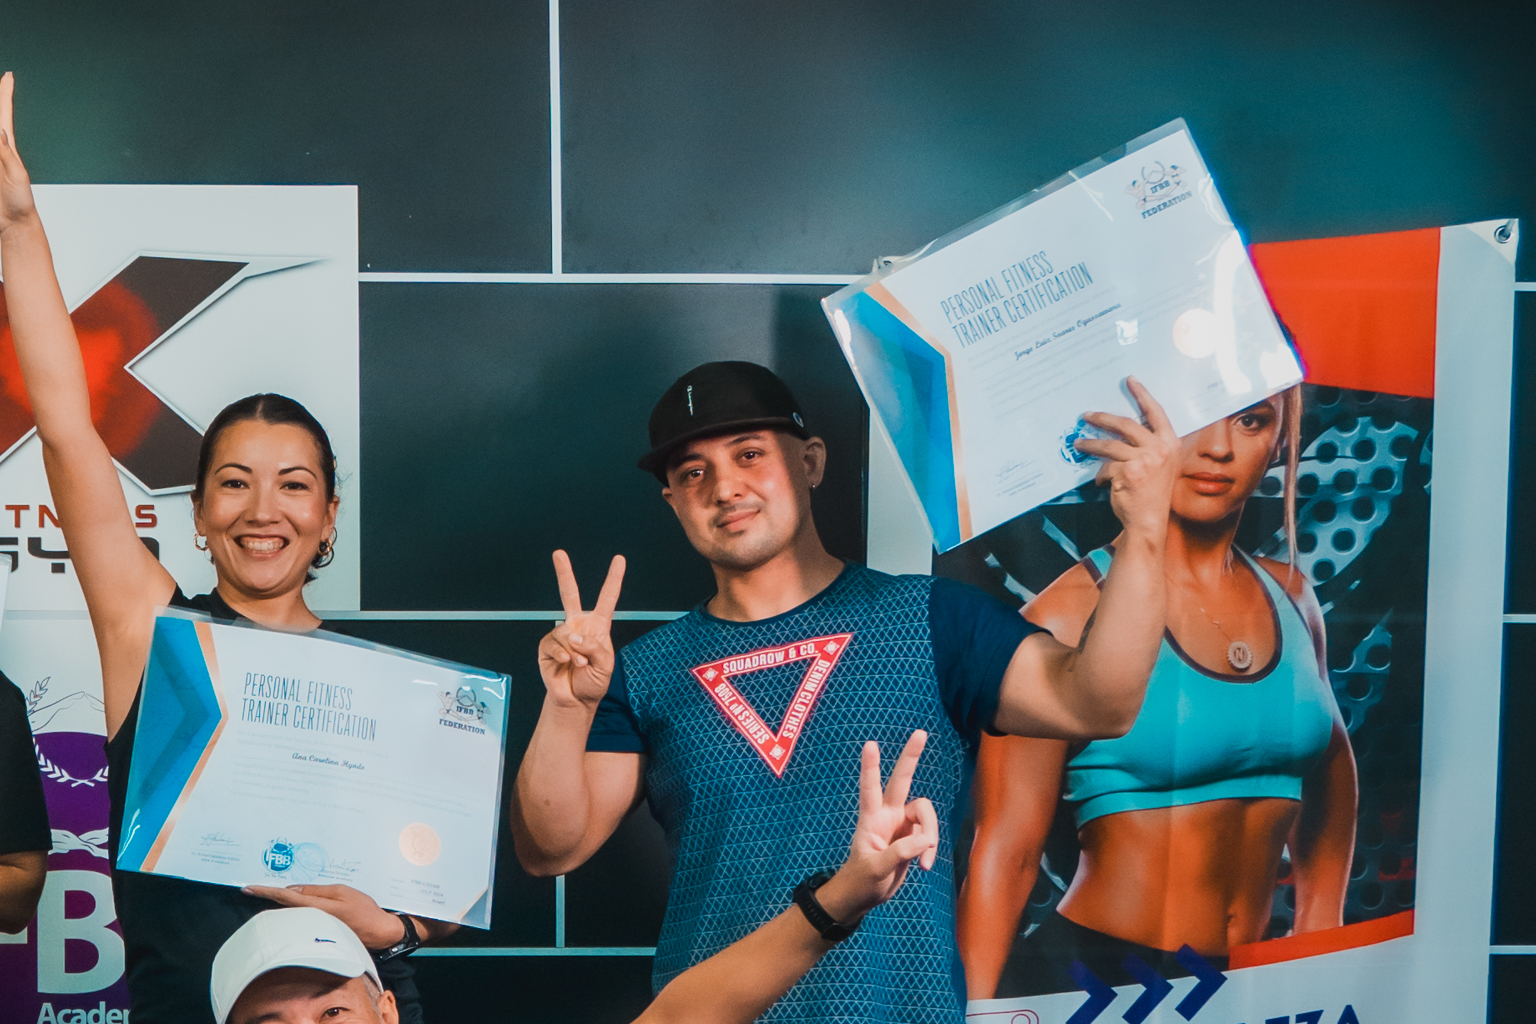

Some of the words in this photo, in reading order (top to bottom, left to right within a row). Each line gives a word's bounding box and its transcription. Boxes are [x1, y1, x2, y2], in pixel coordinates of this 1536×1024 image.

[1141, 190, 1193, 219] FEDERATION
[940, 277, 1005, 324] PERSONAL
[1001, 250, 1053, 294] FITNESS
[952, 306, 1007, 348] TRAINER
[1003, 262, 1093, 323] CERTIFICATION
[723, 651, 784, 674] SQUADROW
[789, 647, 796, 658] &
[800, 643, 818, 656] CO.
[244, 672, 301, 702] PERSONAL
[307, 681, 353, 710] FITNESS
[803, 659, 830, 695] DENIM
[242, 698, 289, 726] TRAINER
[293, 705, 377, 741] CERTIFICATION
[439, 718, 486, 735] FEDERATION
[456, 706, 474, 716] IFBB
[737, 710, 769, 745] SERIES
[783, 691, 812, 739] CLOTHES
[292, 753, 307, 761] Ana
[309, 754, 339, 766] Carolina
